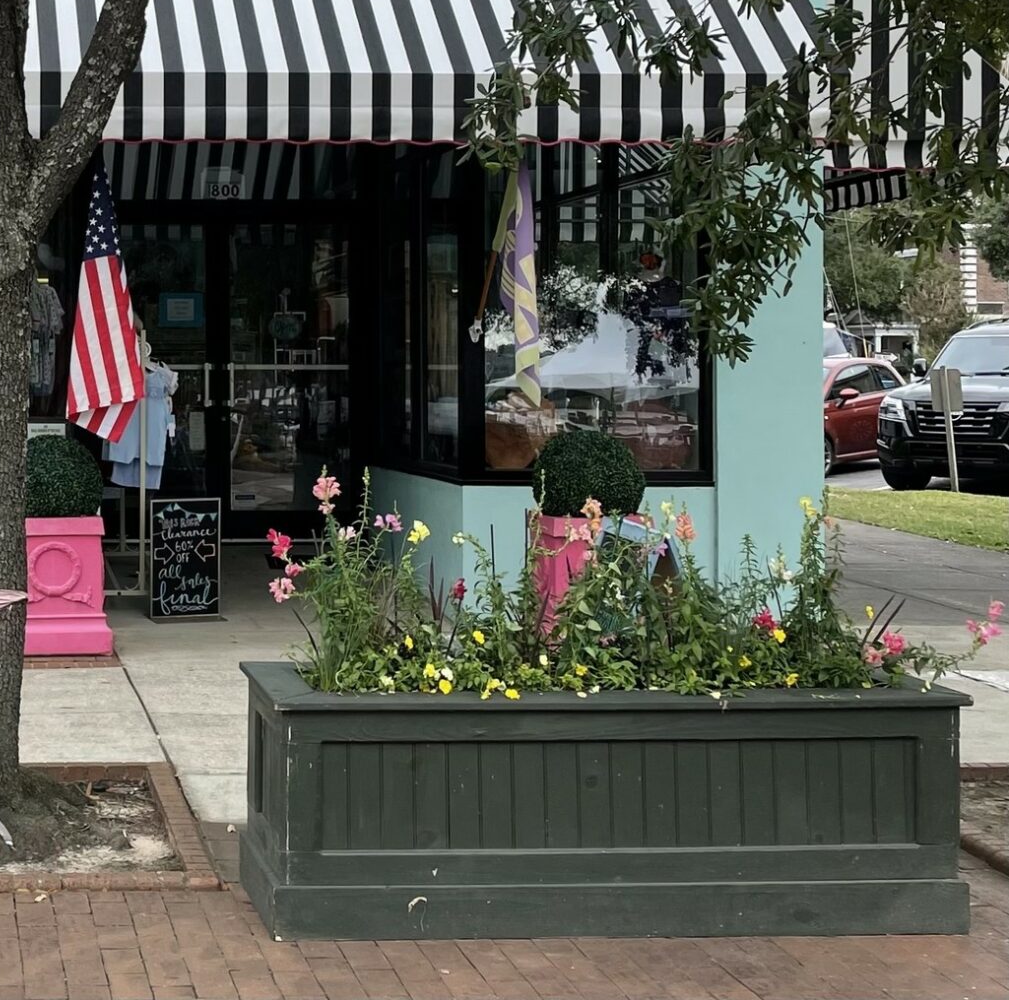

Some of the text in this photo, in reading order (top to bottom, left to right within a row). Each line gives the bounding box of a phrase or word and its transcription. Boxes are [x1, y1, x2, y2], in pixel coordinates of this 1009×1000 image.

[211, 184, 240, 197] 800
[174, 540, 194, 553] 60%
[176, 552, 190, 564] OFF
